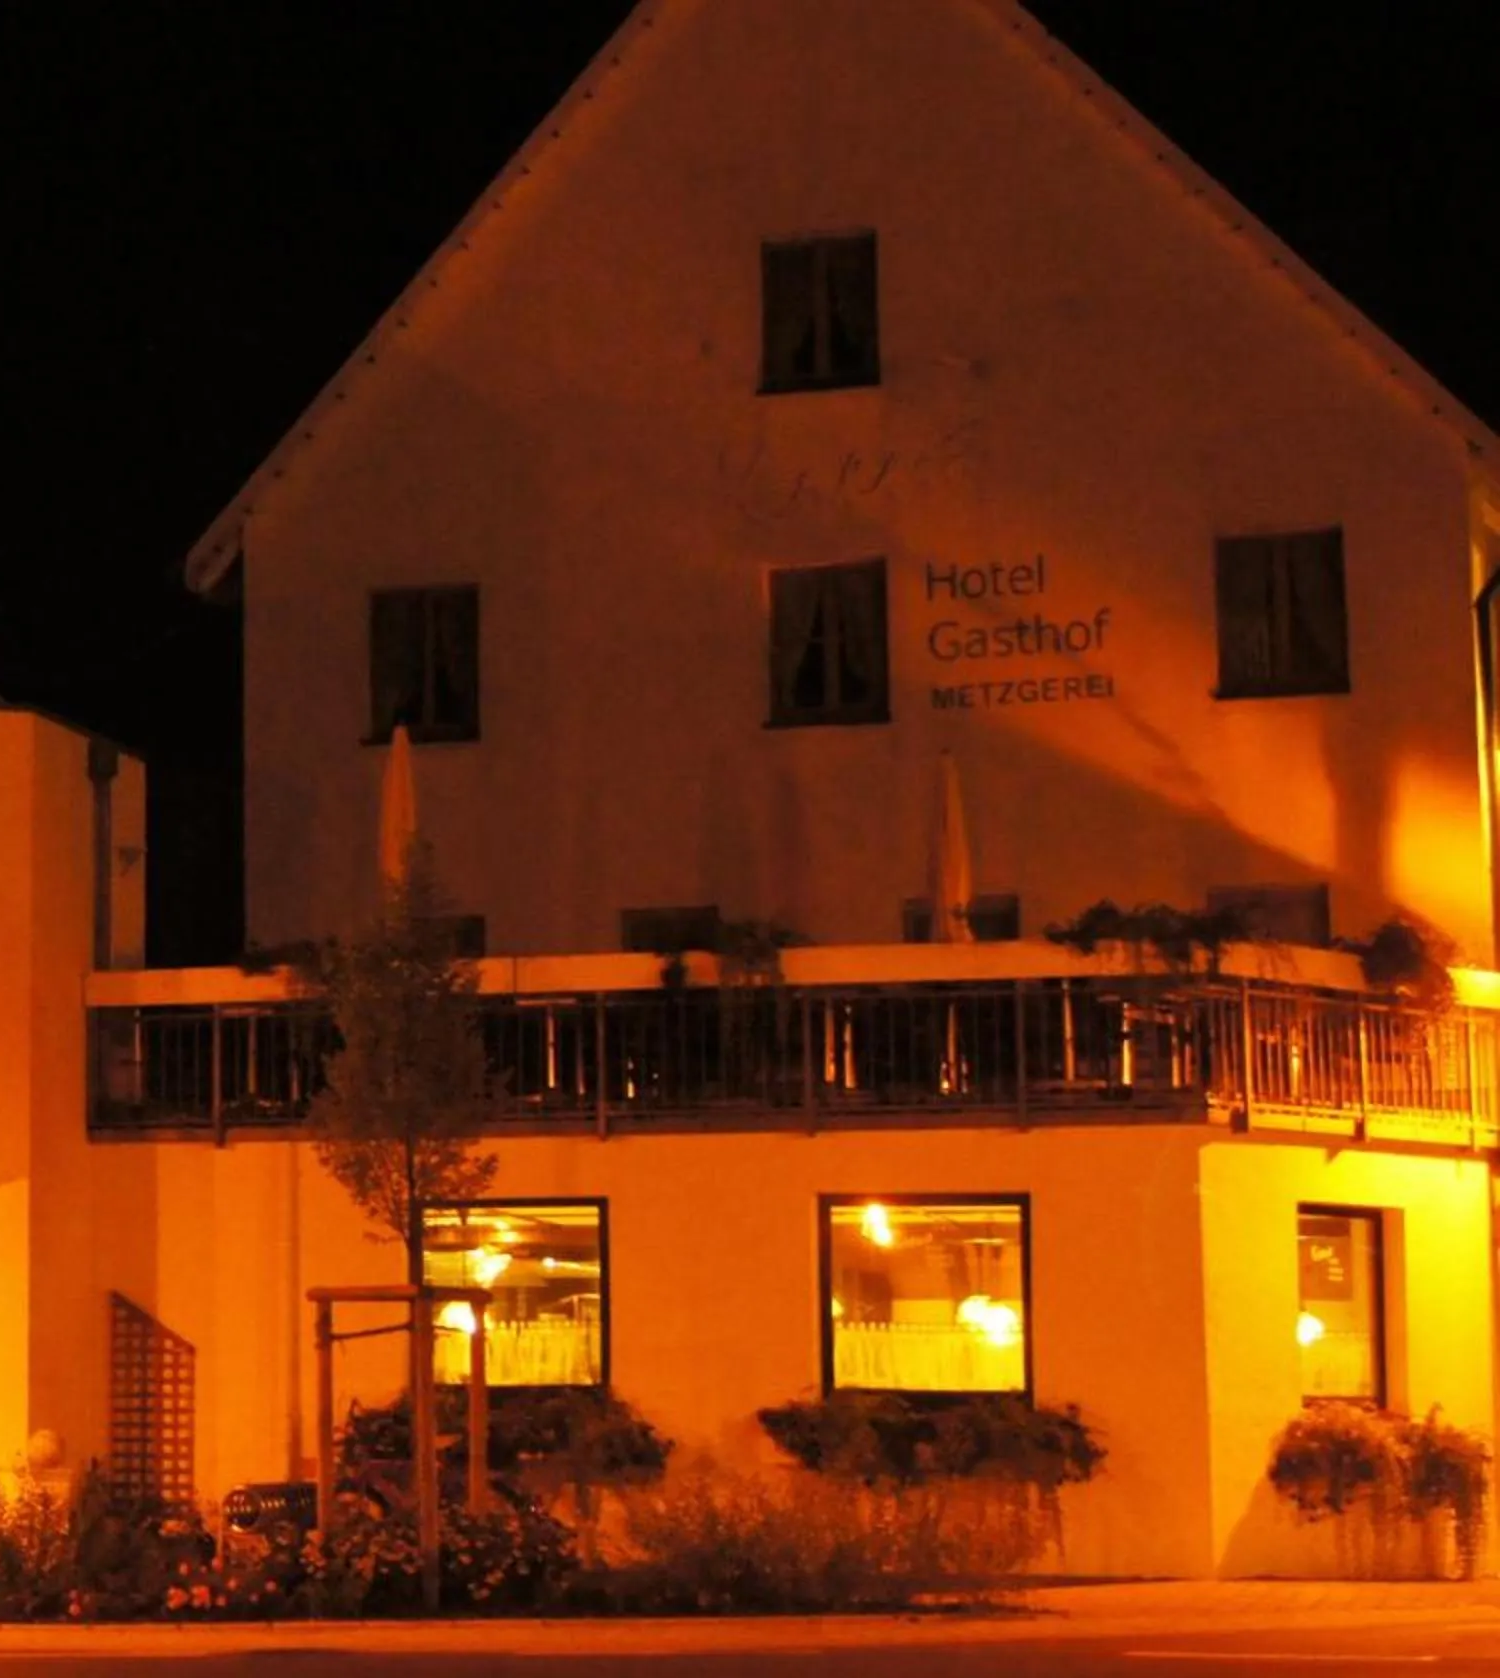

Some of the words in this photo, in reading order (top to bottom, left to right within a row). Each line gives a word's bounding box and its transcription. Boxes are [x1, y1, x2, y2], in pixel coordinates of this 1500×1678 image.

[925, 554, 1046, 602] Hotel
[928, 607, 1112, 663] Gasthof
[931, 673, 1116, 710] METZGEREI
